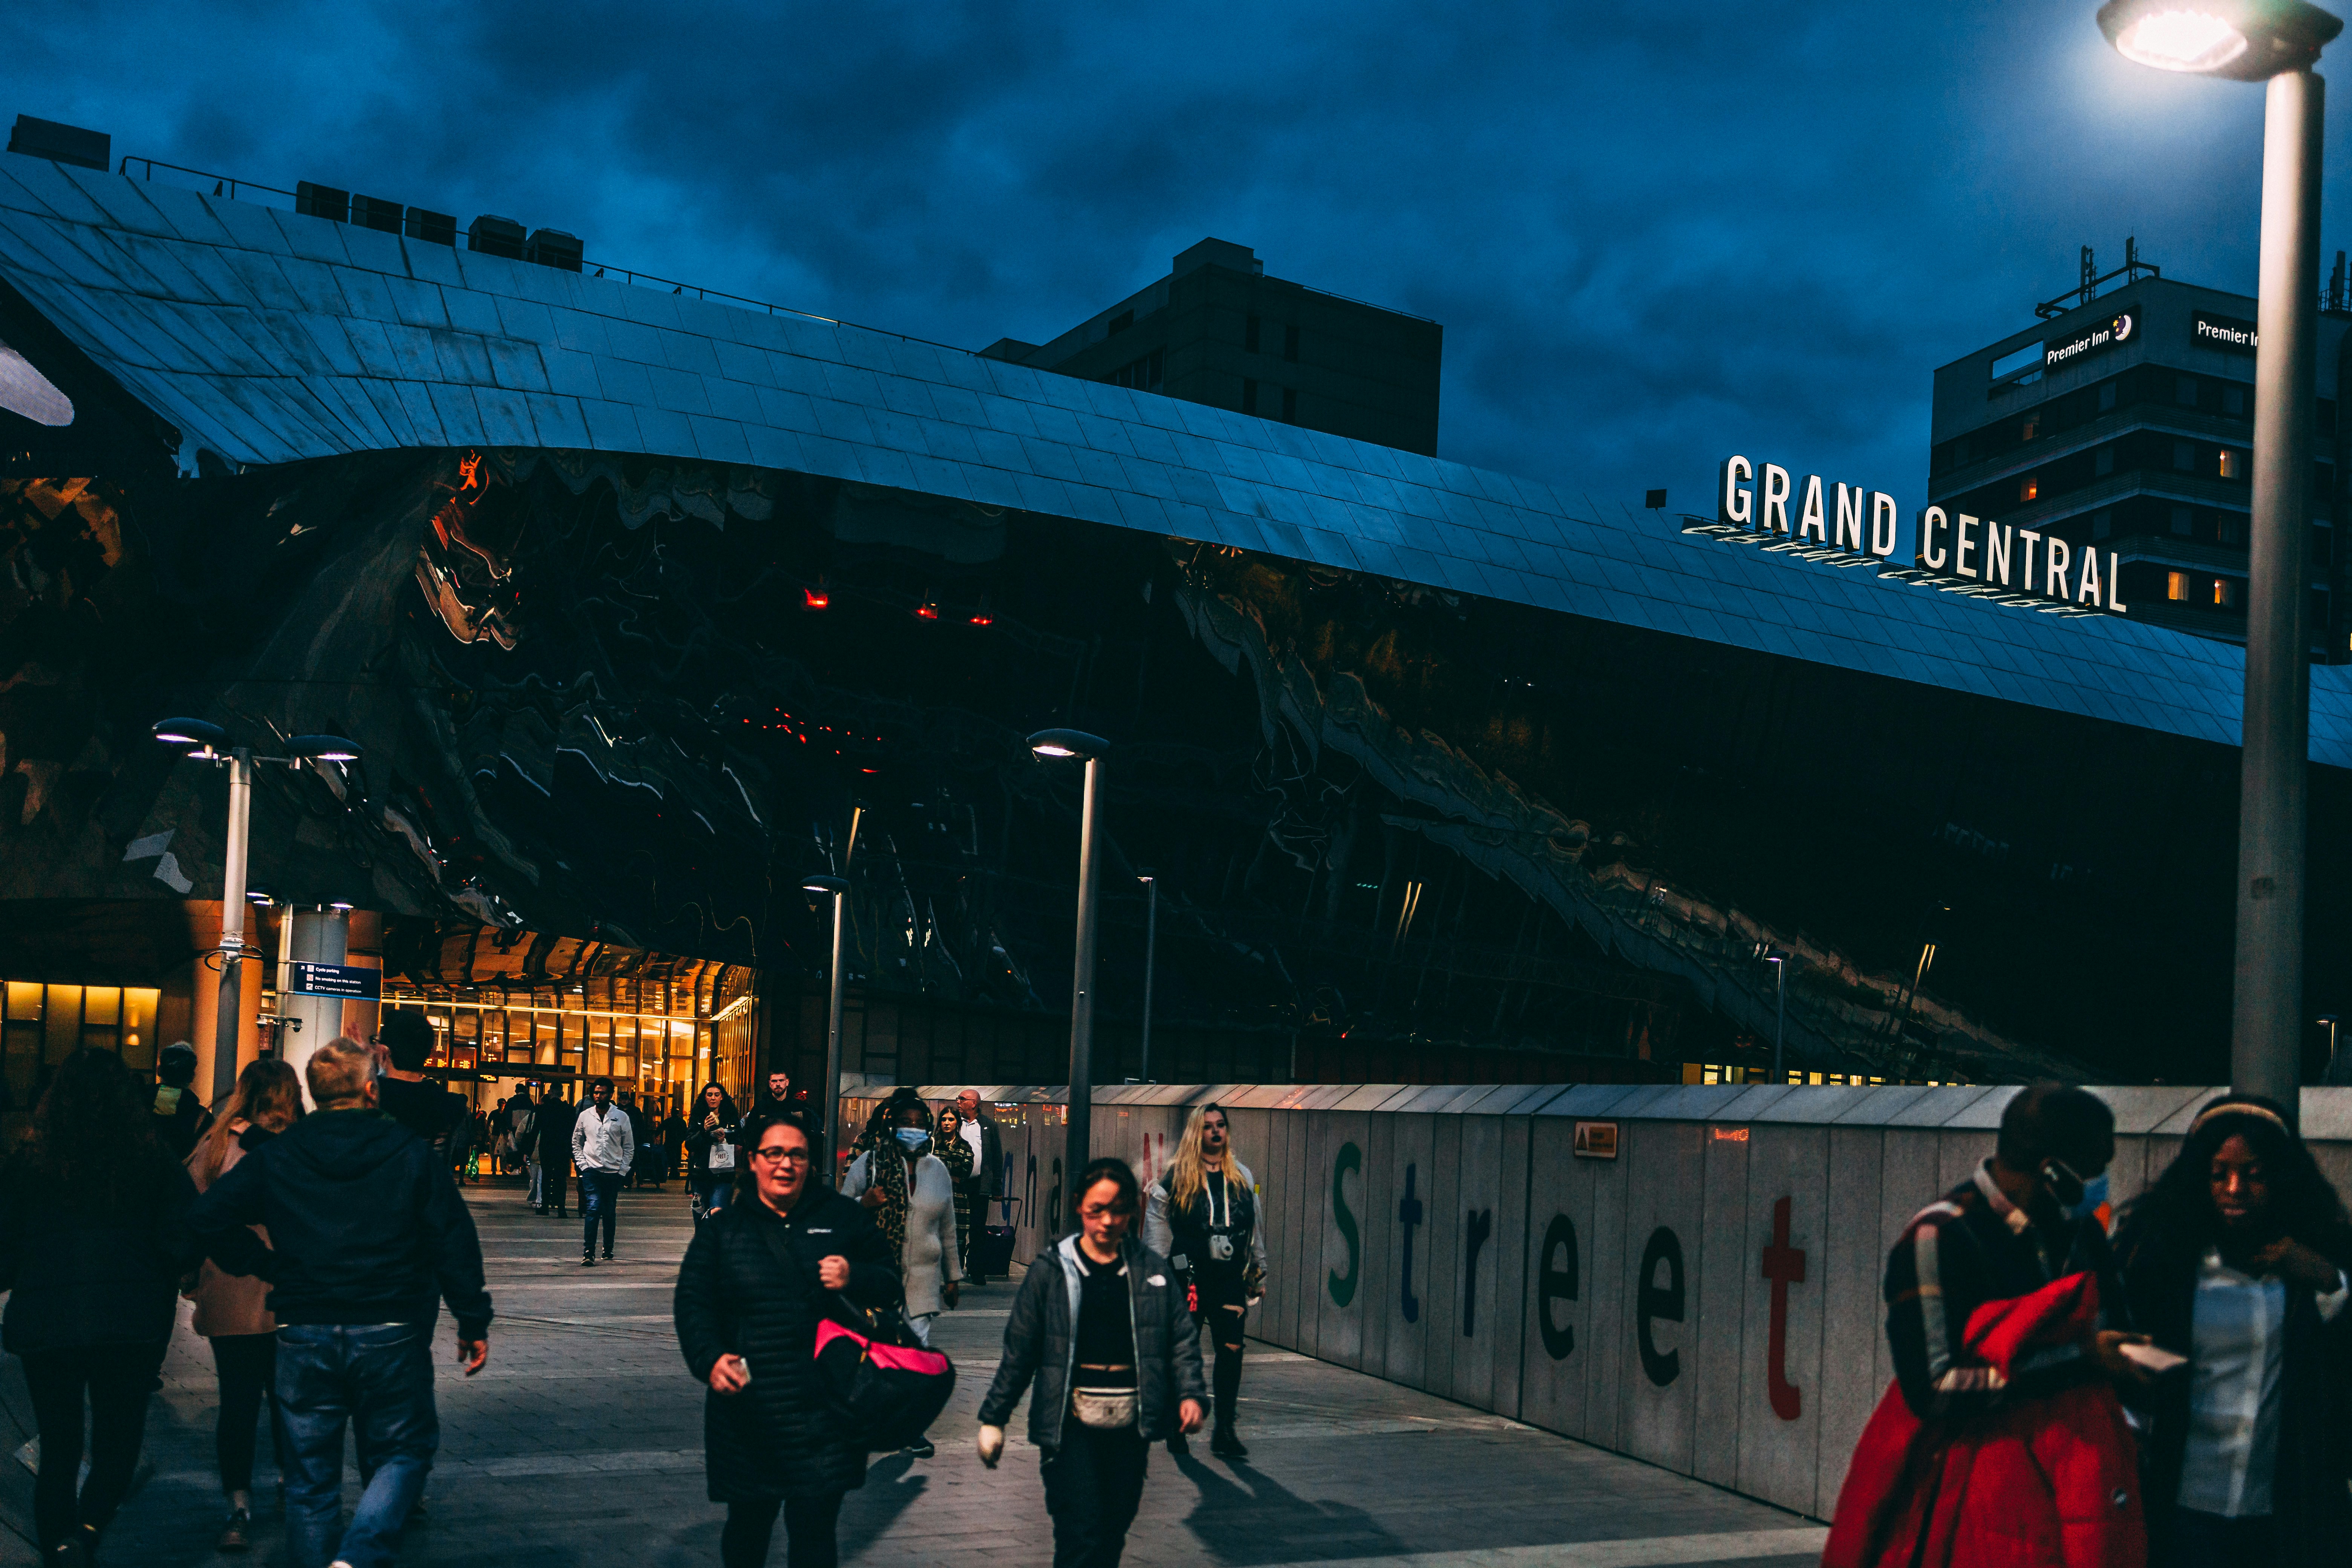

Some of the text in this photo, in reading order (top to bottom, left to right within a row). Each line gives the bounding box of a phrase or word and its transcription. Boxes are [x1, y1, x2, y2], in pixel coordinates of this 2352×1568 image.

[2047, 330, 2109, 365] Premier Inn
[2198, 321, 2248, 344] Premier
[1725, 455, 2127, 613] GRAND CENTRAL
[1328, 1142, 1805, 1421] Street
